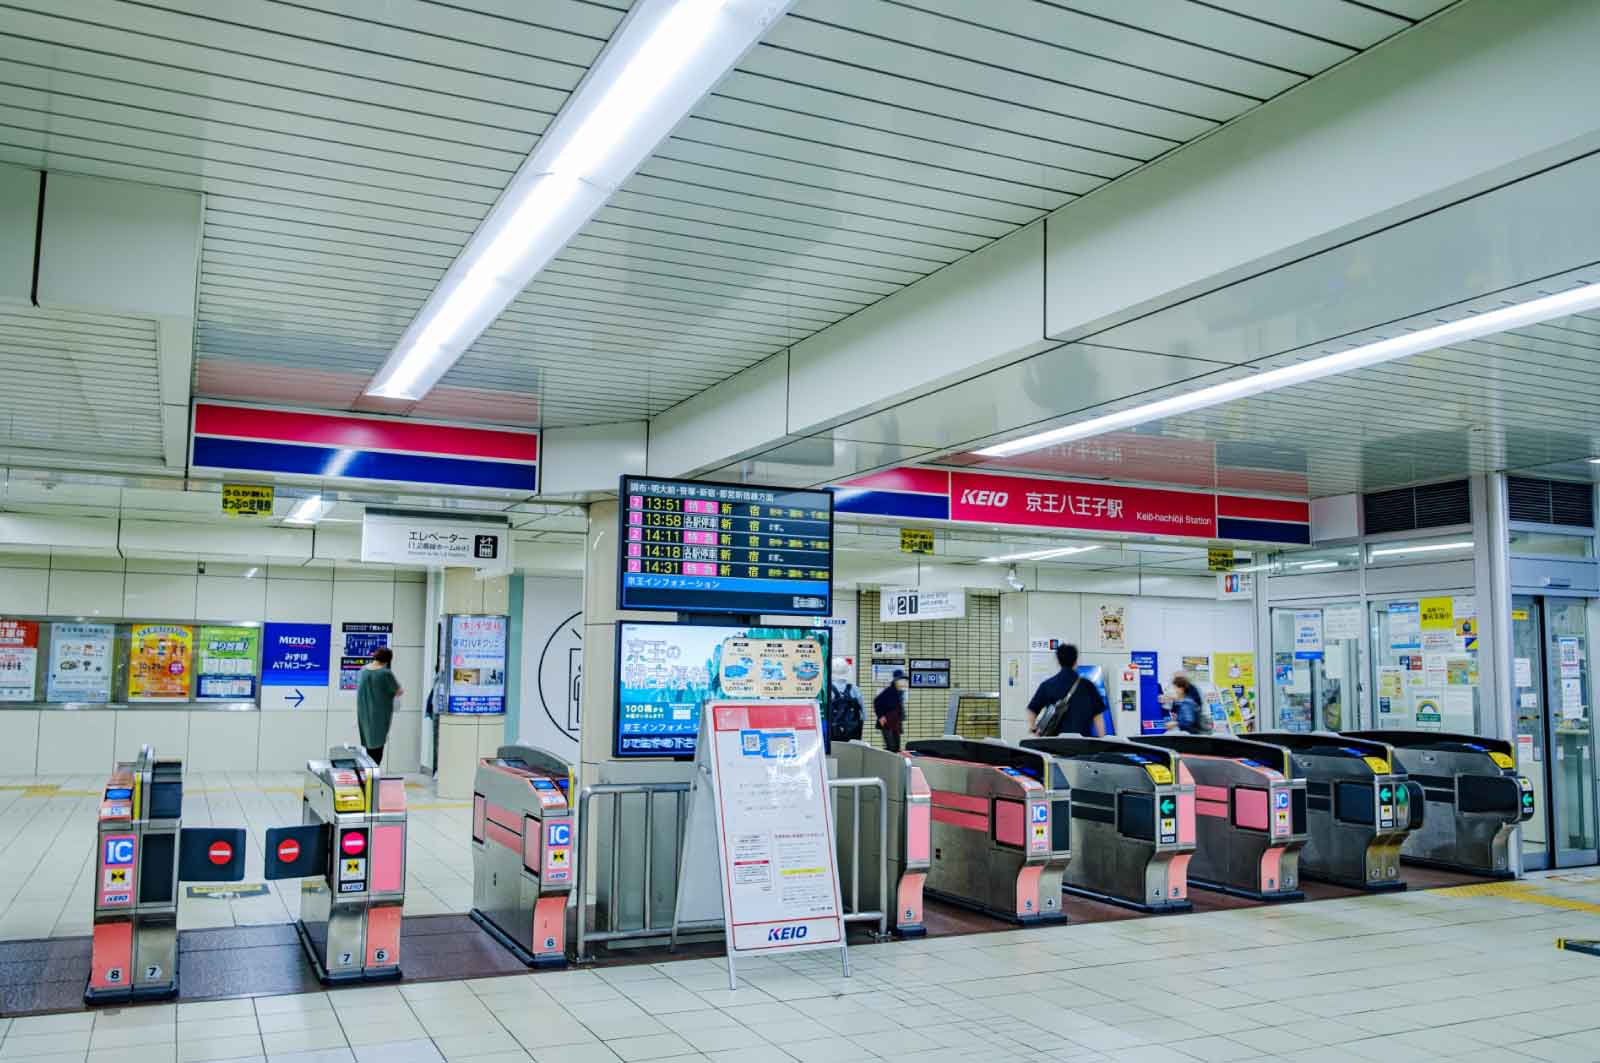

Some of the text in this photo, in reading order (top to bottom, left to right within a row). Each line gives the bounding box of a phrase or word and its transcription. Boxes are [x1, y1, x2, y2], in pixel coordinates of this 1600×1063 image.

[647, 498, 680, 511] 13:51
[960, 488, 1009, 507] KEIO
[1026, 491, 1124, 518] 京王八王子駅
[646, 513, 682, 527] 13:58
[1185, 515, 1212, 525] Station
[409, 532, 469, 543] エレベーター
[646, 529, 680, 543] 14:11
[645, 544, 681, 558] 14:18
[645, 560, 679, 574] 14:31
[279, 636, 316, 645] MIZUHO
[284, 652, 309, 661] みずほ
[272, 661, 320, 670] ATMコーナー
[1276, 793, 1288, 808] IC
[1032, 804, 1047, 822] IC
[549, 825, 569, 845] IC
[106, 840, 133, 863] IC
[768, 926, 807, 941] KEIO
[111, 966, 158, 979] 8 7
